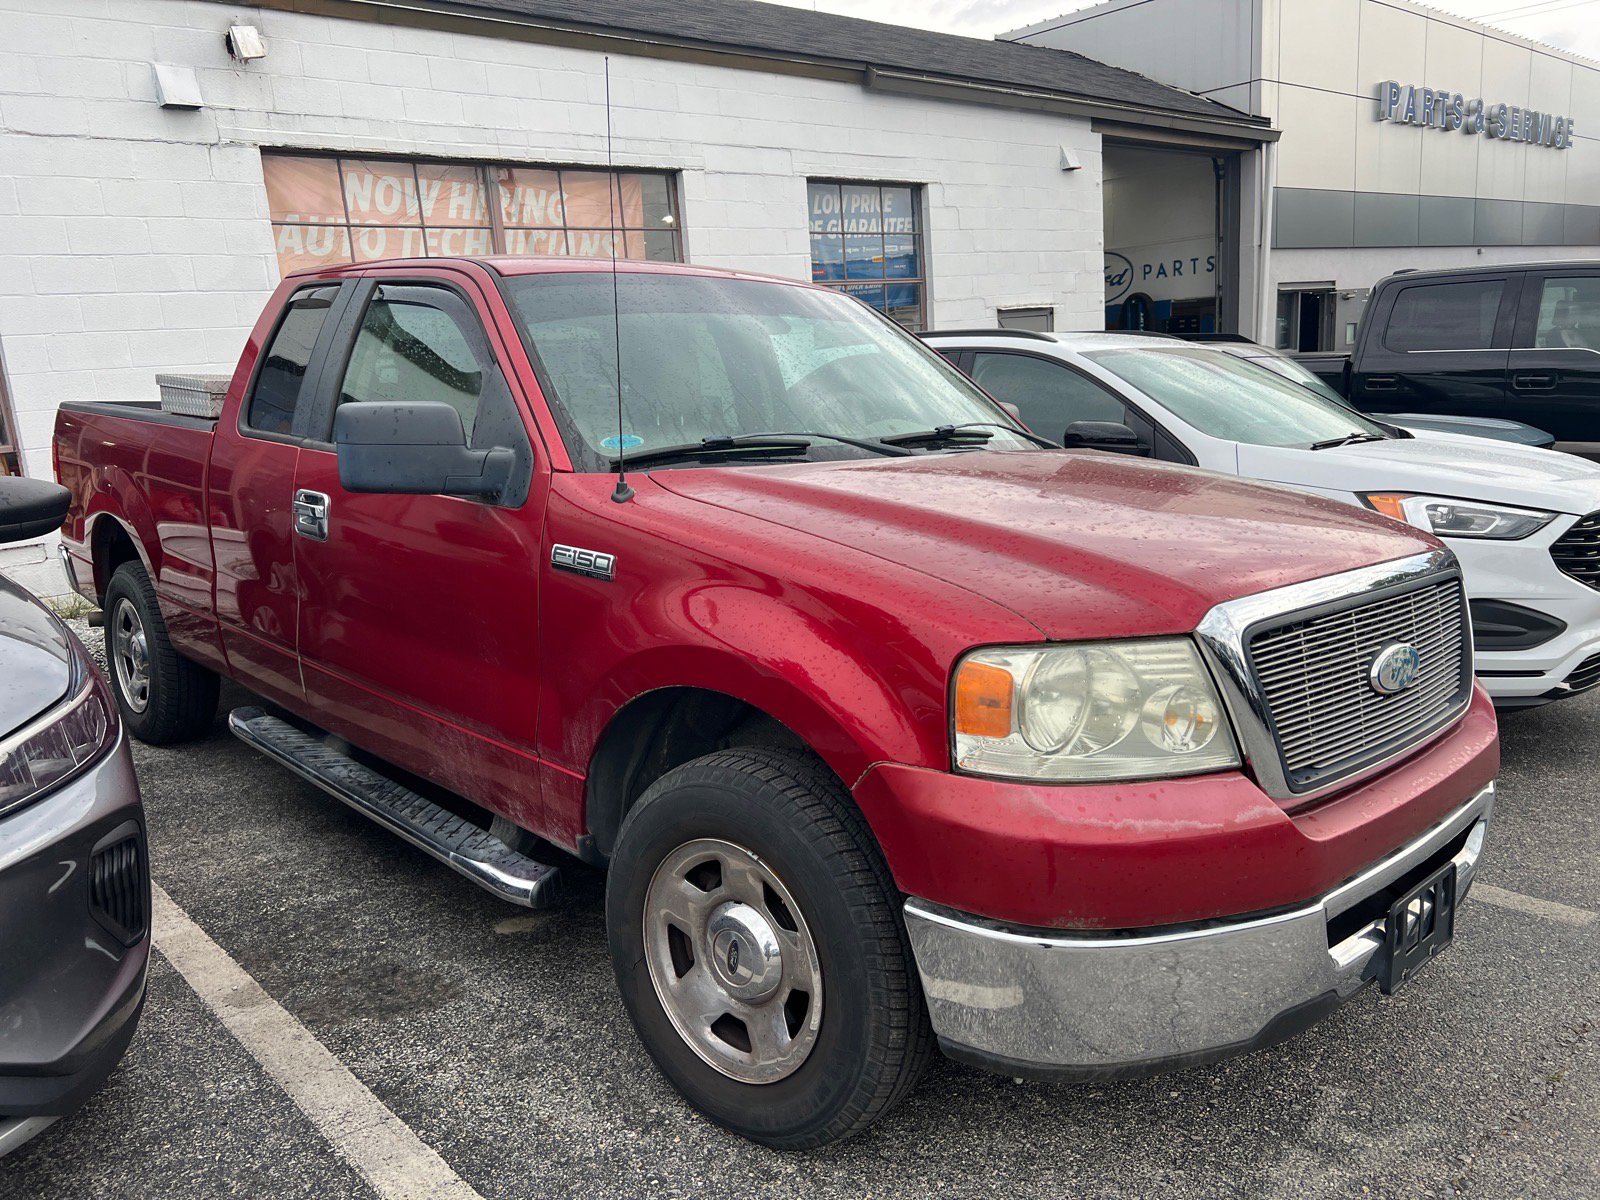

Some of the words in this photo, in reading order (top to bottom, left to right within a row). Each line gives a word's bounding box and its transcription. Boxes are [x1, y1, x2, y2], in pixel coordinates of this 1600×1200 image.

[1382, 80, 1464, 130] PARTS
[1472, 97, 1486, 134] &
[1495, 103, 1575, 149] SERVICE
[346, 172, 441, 218] NOW
[448, 182, 568, 226] HIRING
[814, 193, 848, 215] LOW
[851, 192, 893, 213] PRICE
[276, 214, 387, 259] AUTO
[827, 217, 912, 239] GUARANTEE
[1143, 256, 1216, 280] PARTS
